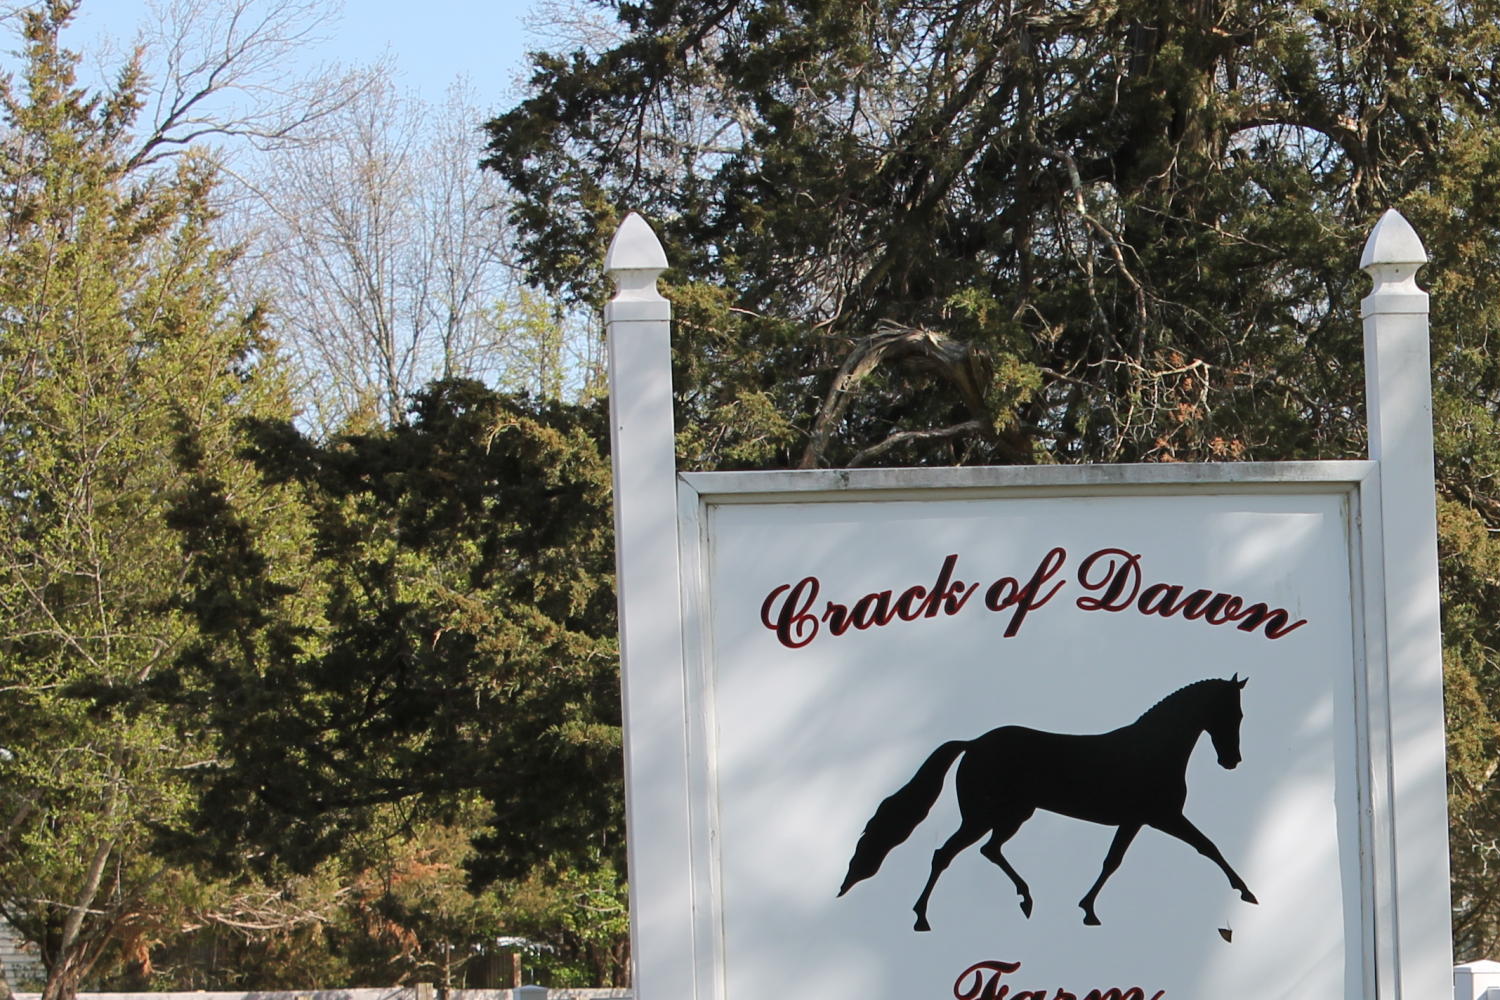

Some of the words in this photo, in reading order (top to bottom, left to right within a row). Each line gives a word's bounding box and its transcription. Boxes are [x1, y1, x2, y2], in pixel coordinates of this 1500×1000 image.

[760, 553, 980, 649] Crack
[984, 547, 1067, 638] of
[1075, 547, 1308, 640] Dawn
